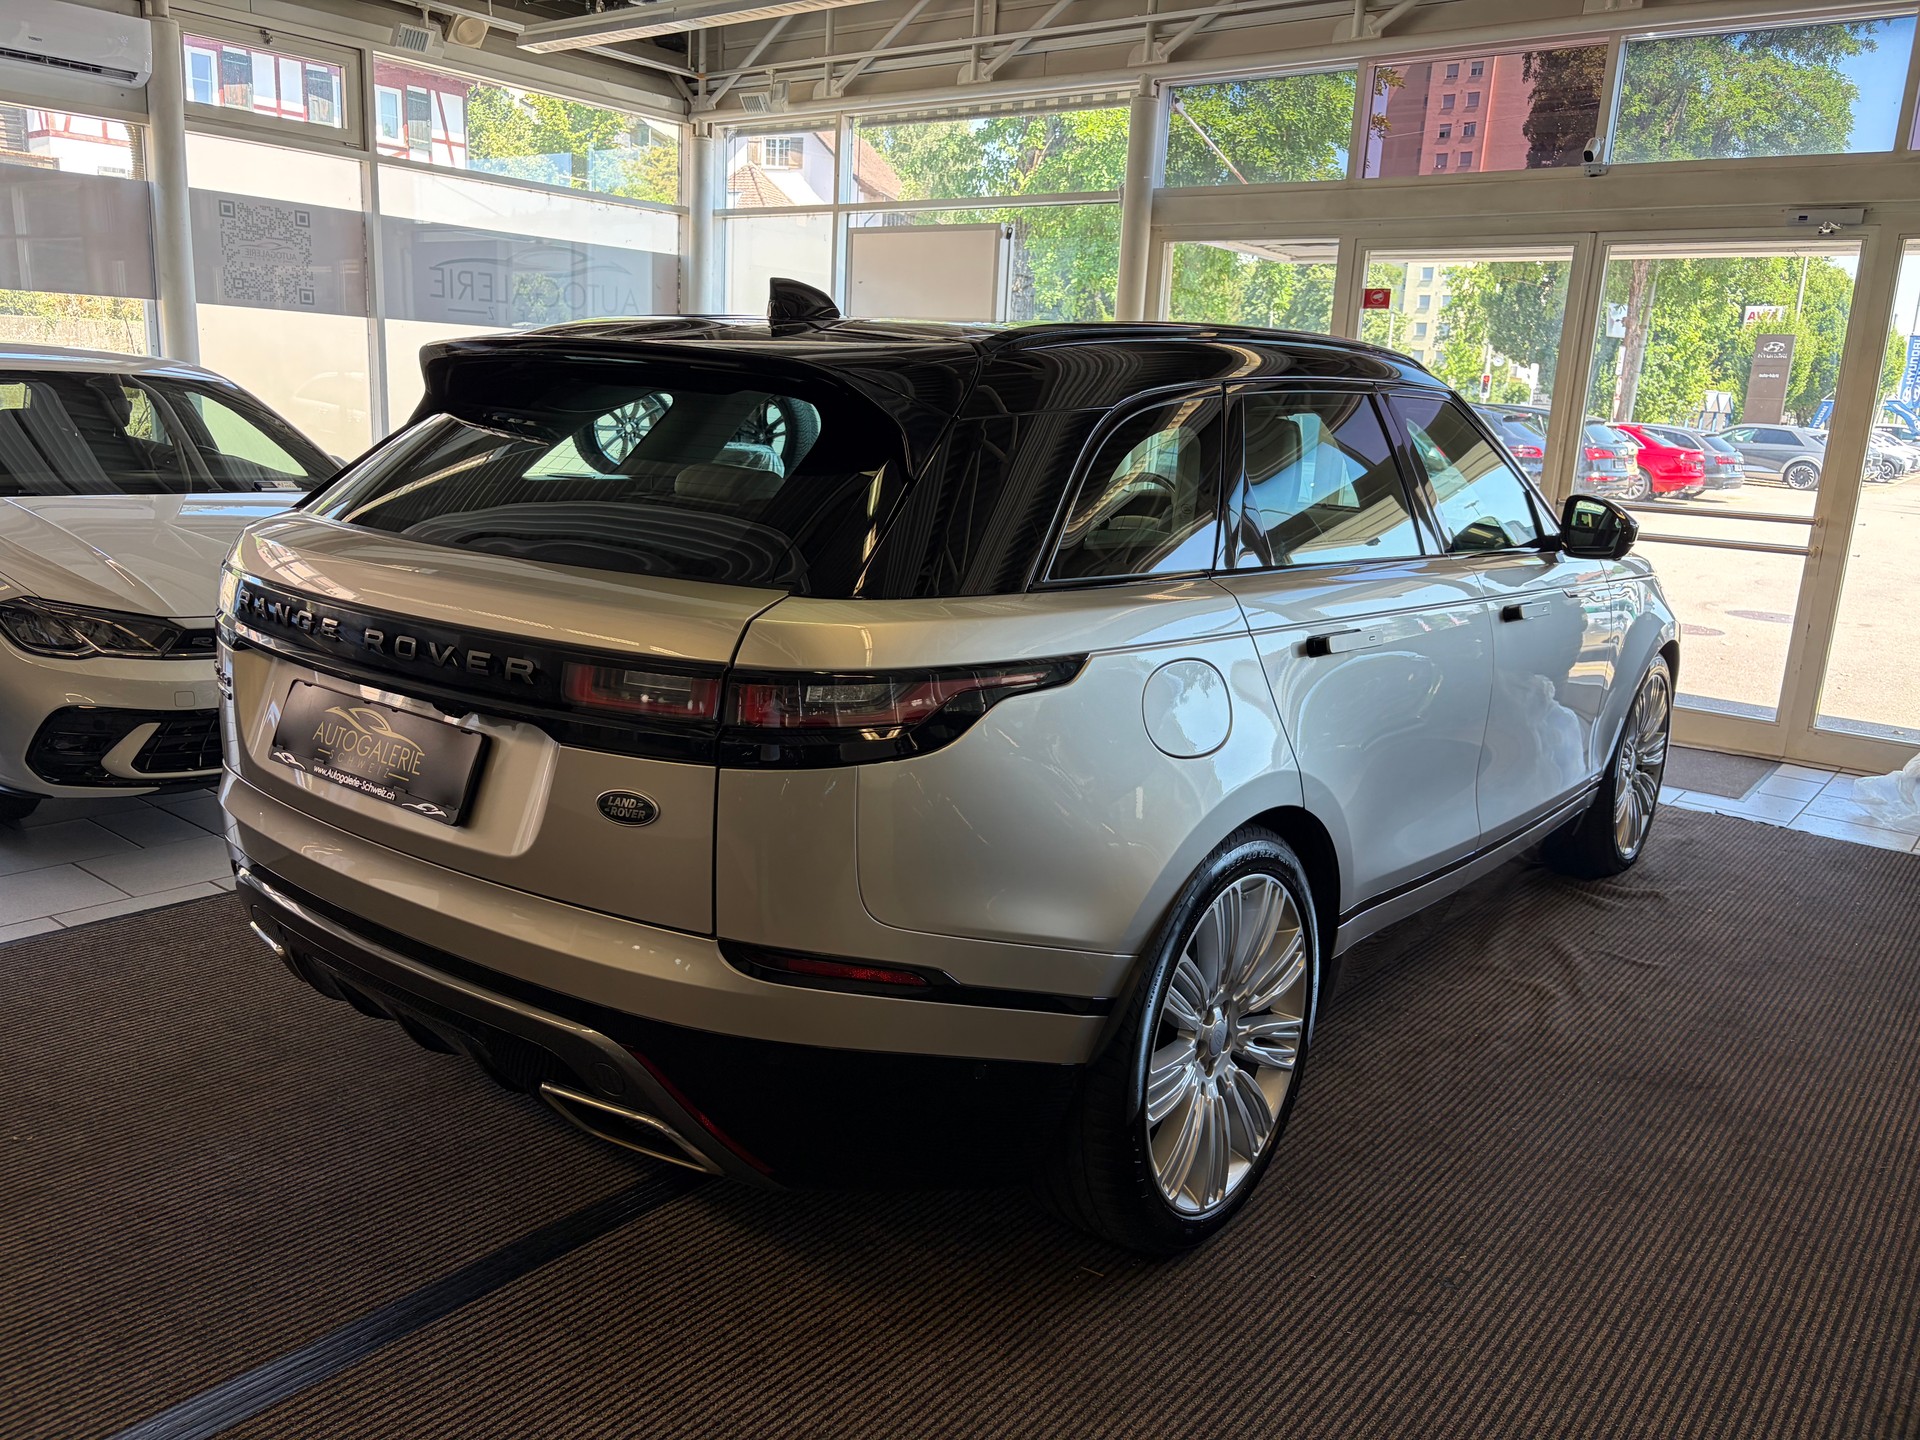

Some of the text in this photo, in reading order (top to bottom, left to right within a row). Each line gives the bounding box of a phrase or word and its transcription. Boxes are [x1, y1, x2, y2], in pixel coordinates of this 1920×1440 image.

[238, 588, 534, 685] RANGE ROVER
[312, 721, 425, 776] AUTOGALERIE
[329, 749, 389, 779] SCHWEIZ
[313, 765, 396, 801] www.Autogalerie-Schweiz.ch
[607, 796, 637, 808] LAND
[610, 806, 646, 820] ROVER
